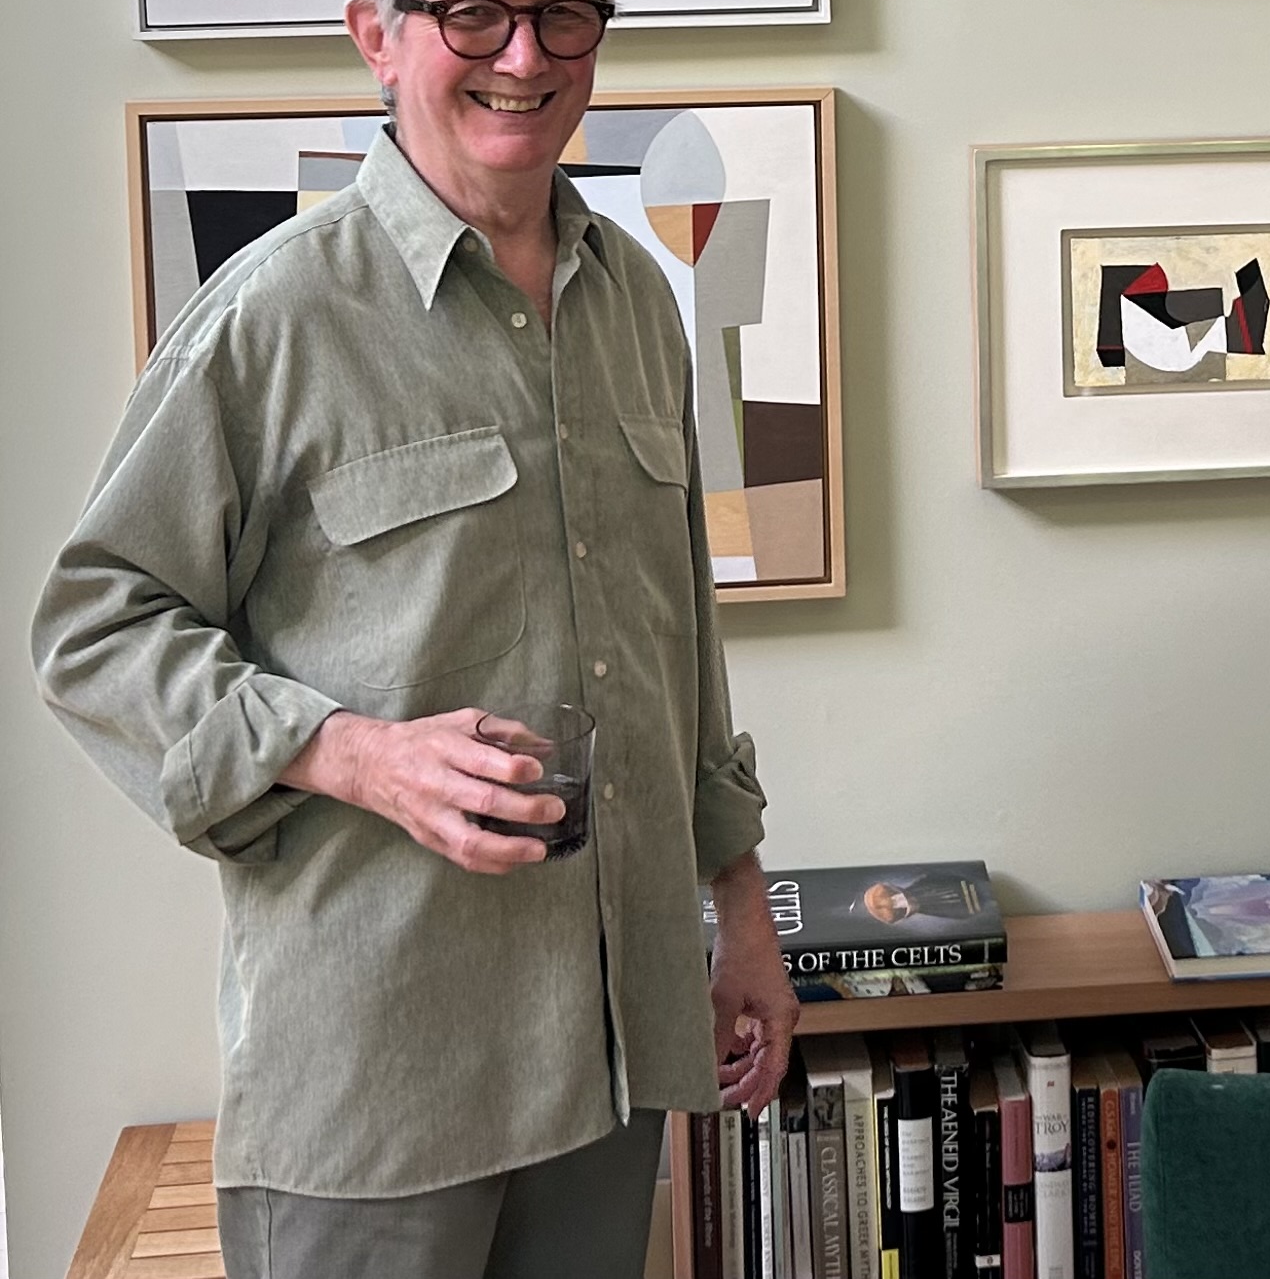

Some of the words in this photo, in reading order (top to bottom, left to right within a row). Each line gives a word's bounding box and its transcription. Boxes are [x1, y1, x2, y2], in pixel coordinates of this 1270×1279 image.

[767, 880, 803, 936] CELTS
[798, 951, 831, 973] OF
[836, 948, 885, 971] THE
[890, 943, 963, 967] CELTS
[940, 1071, 958, 1106] THE
[940, 1107, 959, 1172] AENEID
[1035, 1120, 1069, 1135] TROY
[1087, 1096, 1096, 1192] REDISCOVERING
[702, 1142, 712, 1158] and
[853, 1113, 868, 1188] APPROACHES
[1127, 1141, 1142, 1170] THE
[820, 1146, 840, 1232] CLASSICAL
[1107, 1152, 1117, 1198] HOMER
[1127, 1174, 1142, 1213] ILIAD
[857, 1190, 869, 1207] TO
[942, 1176, 960, 1233] VIRGIL
[1088, 1194, 1097, 1234] HOMER
[1109, 1198, 1118, 1225] AND
[858, 1210, 869, 1247] GREEK
[1110, 1225, 1119, 1248] THE
[859, 1249, 871, 1279] MYTH
